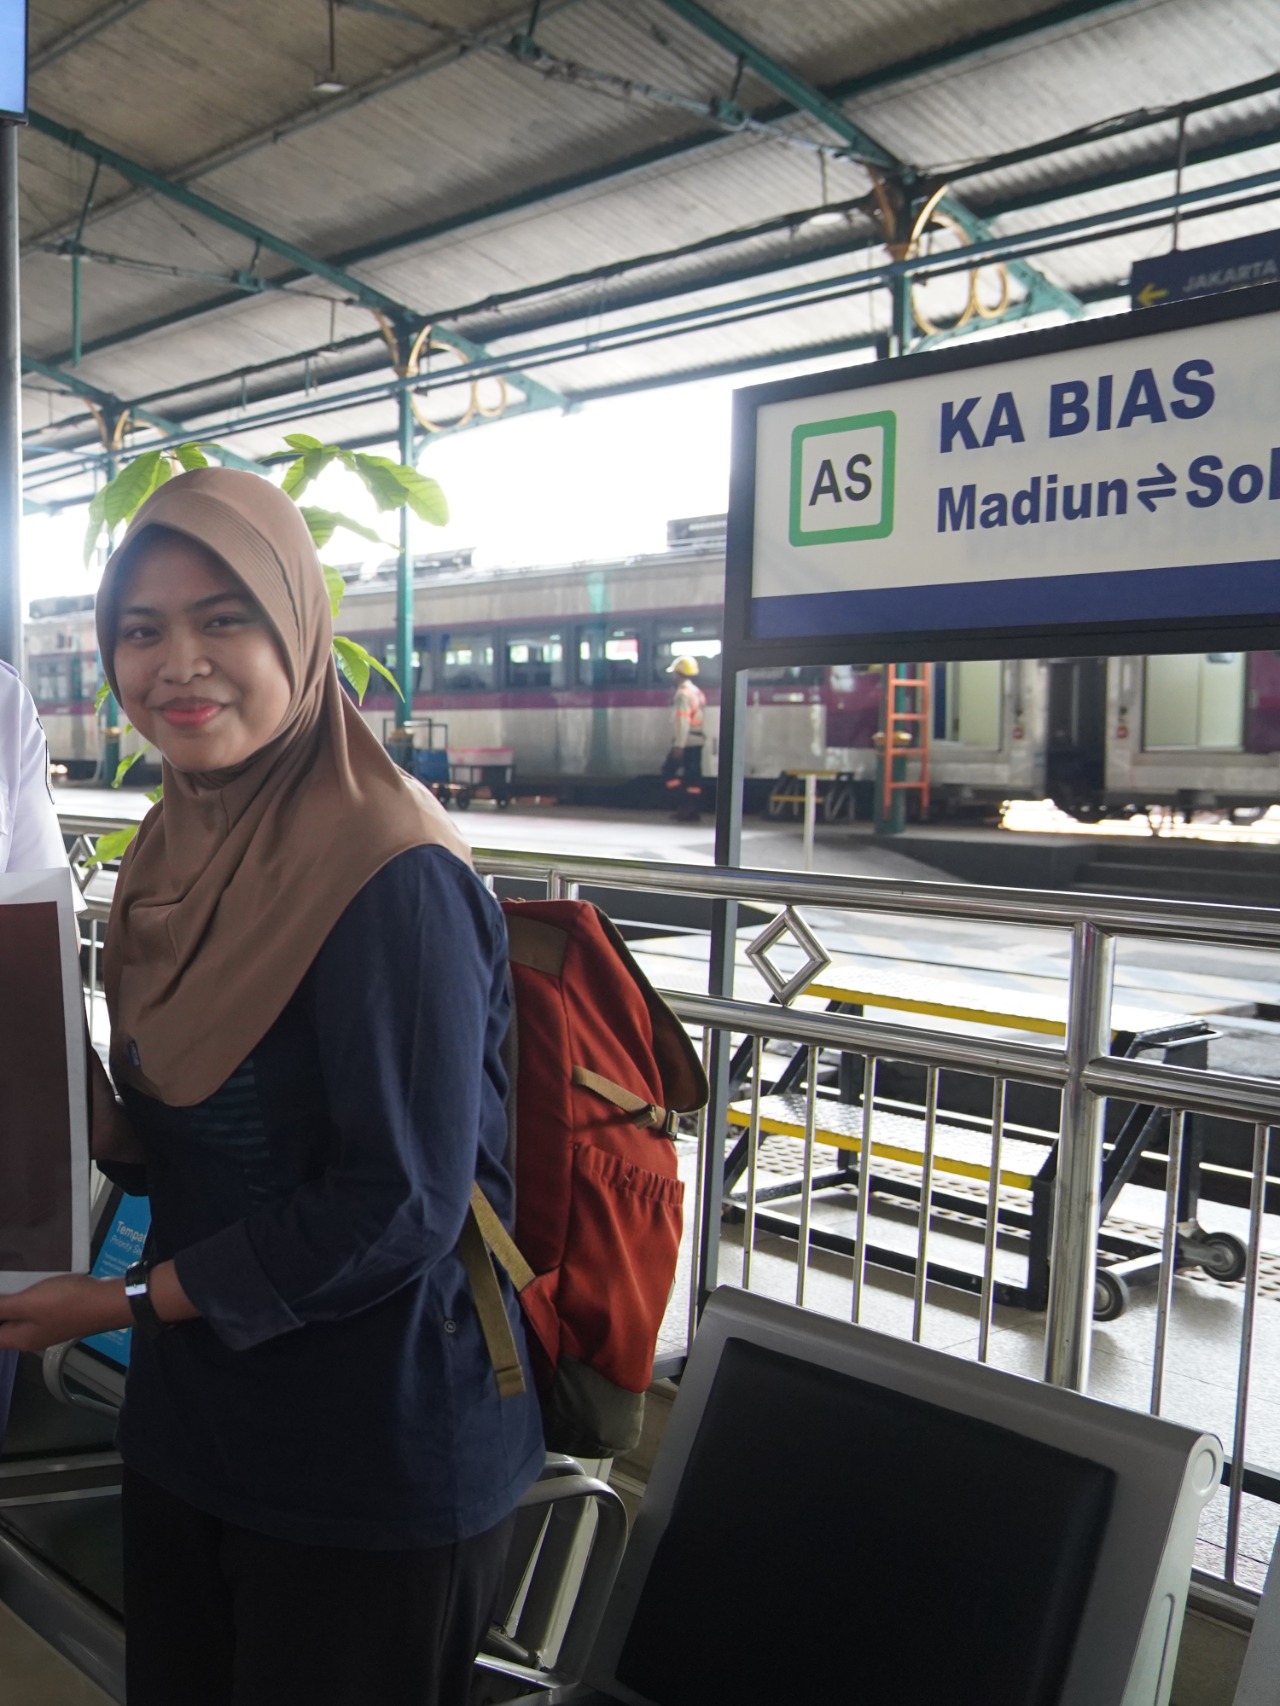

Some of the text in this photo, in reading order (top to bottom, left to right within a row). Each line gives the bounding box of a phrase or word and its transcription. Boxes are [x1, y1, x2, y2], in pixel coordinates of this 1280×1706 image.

[1182, 259, 1279, 293] JAKARTA
[939, 358, 1216, 454] KA BIAS
[808, 453, 874, 507] AS
[937, 474, 1129, 533] Madiun
